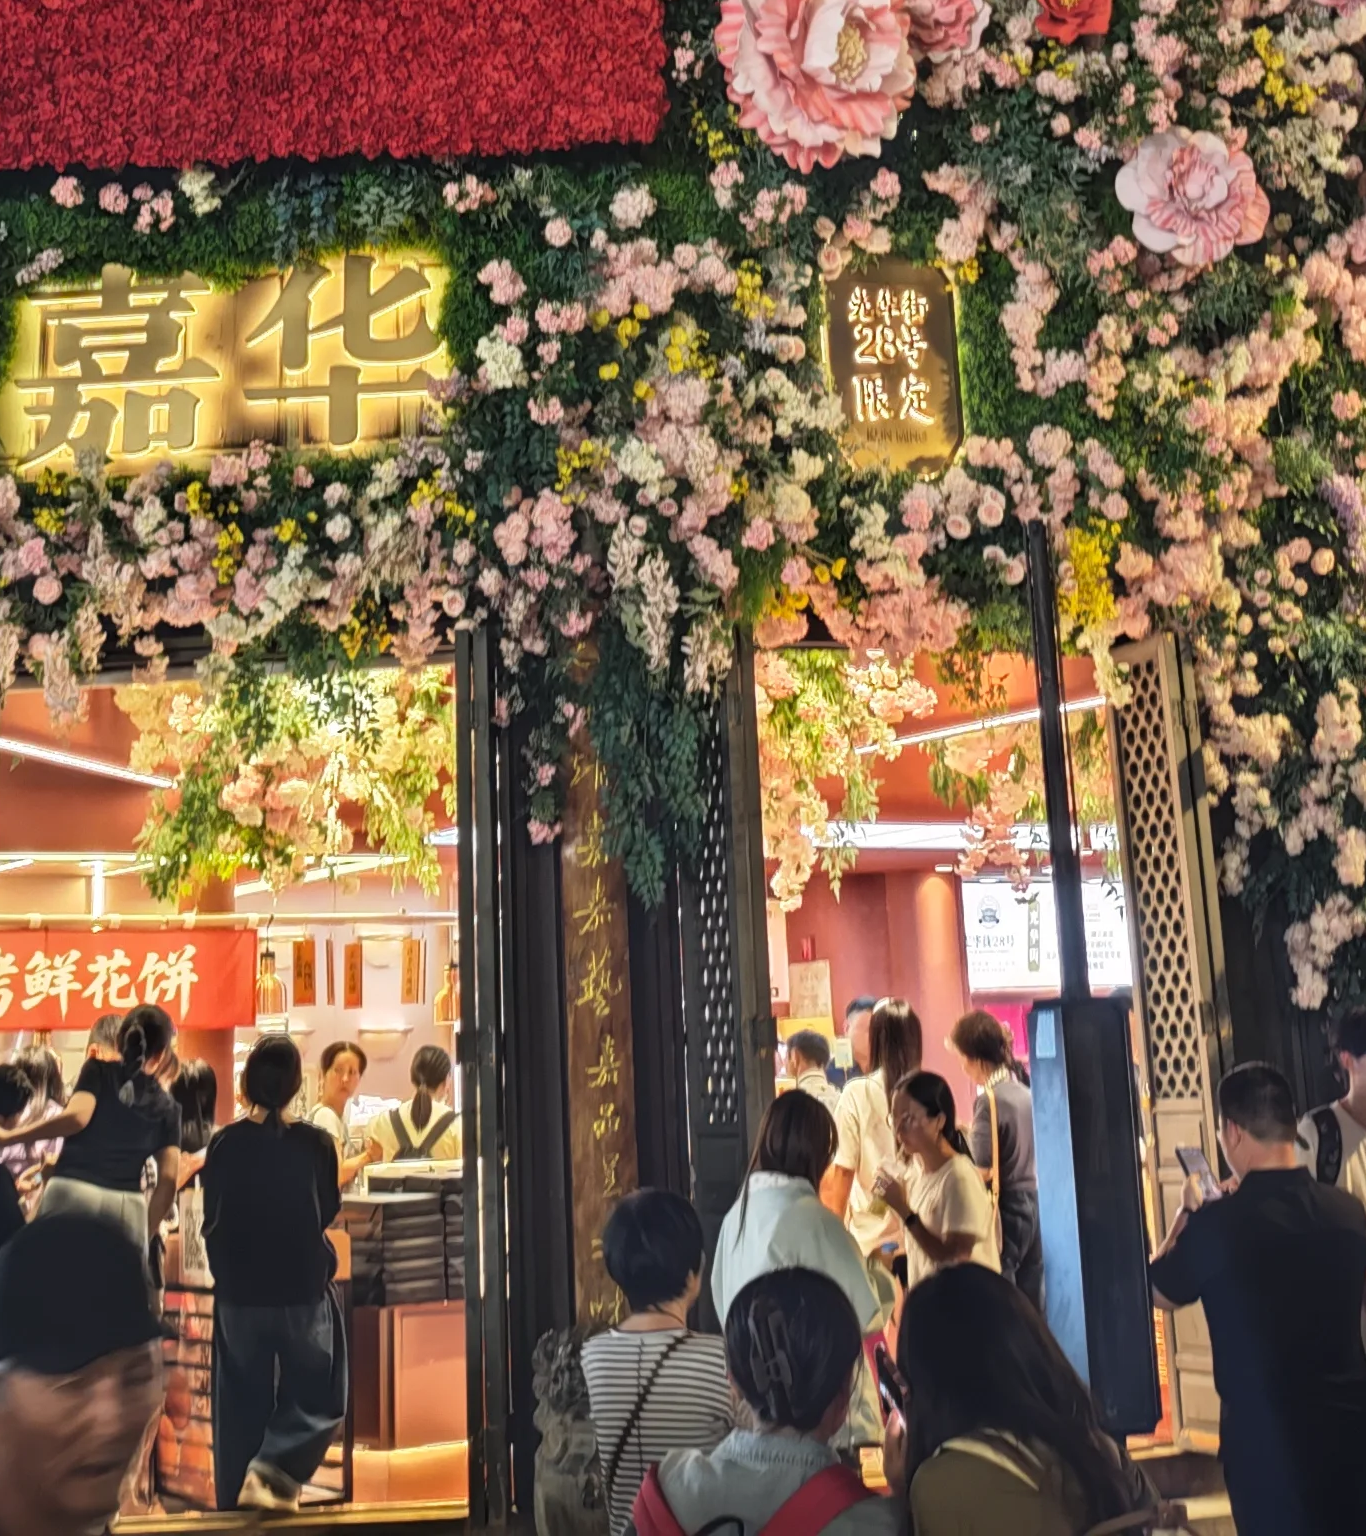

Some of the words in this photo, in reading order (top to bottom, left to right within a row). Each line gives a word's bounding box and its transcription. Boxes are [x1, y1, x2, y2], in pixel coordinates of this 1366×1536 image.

[848, 285, 930, 326] 光华街
[15, 254, 446, 469] 嘉华
[853, 322, 929, 370] 28号
[852, 372, 936, 426] 限定
